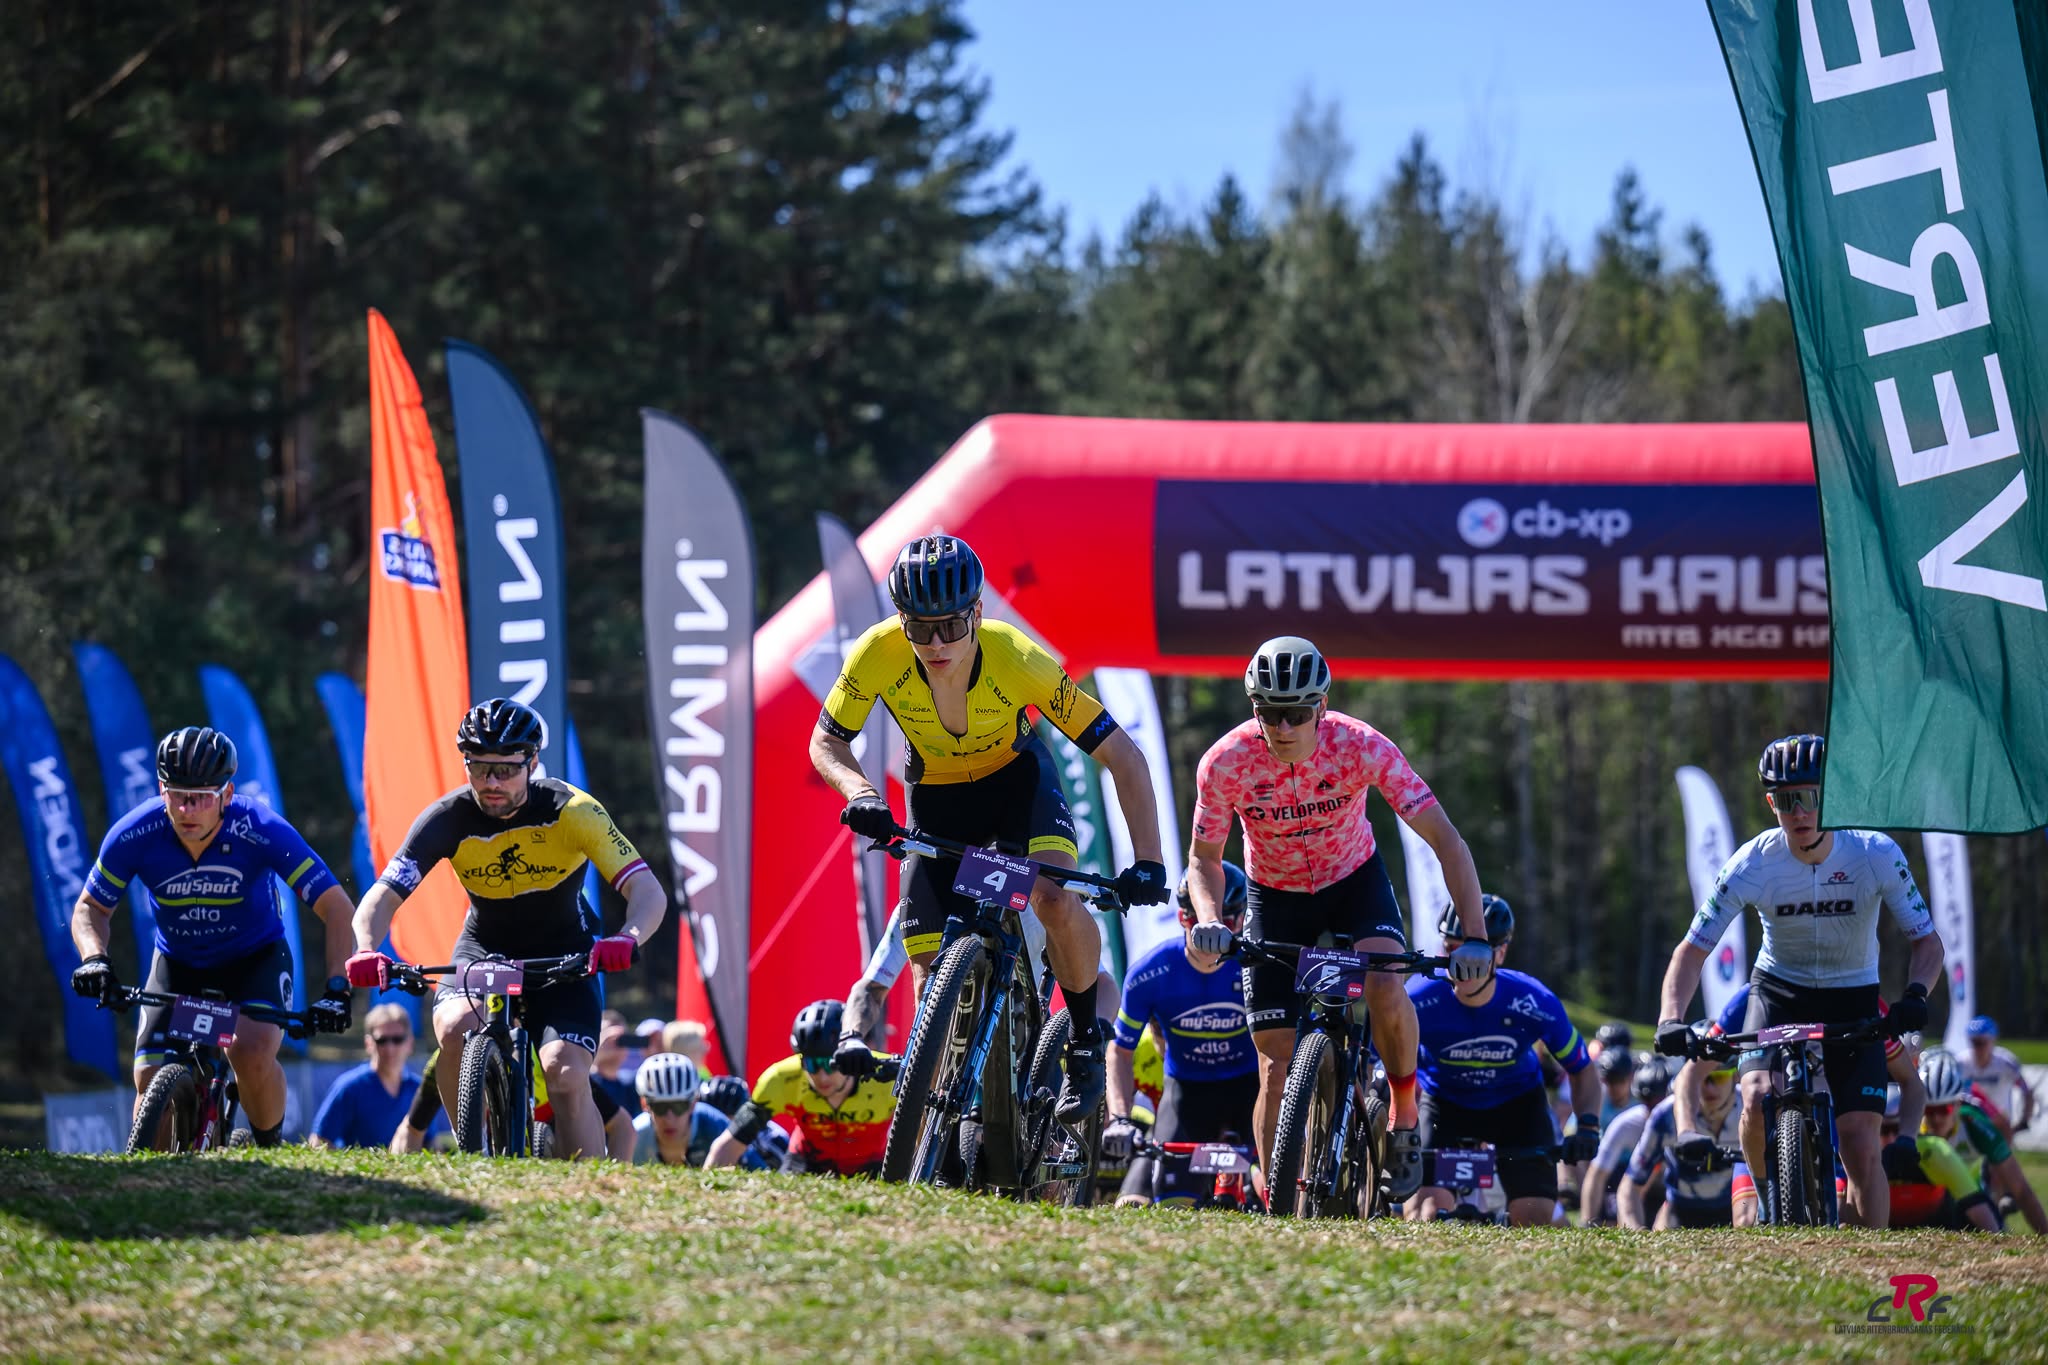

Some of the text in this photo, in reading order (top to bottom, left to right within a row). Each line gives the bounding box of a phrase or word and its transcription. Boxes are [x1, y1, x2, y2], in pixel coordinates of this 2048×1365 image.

[1512, 500, 1631, 547] cb-xp
[1178, 551, 1590, 616] LATVIJAS
[1622, 624, 1701, 649] MTB
[1711, 625, 1784, 649] XCO
[895, 666, 913, 689] ELOT
[992, 686, 1014, 708] ELOT
[1271, 793, 1352, 821] VELOPROFS
[972, 852, 1005, 866] LATVIJAS
[1006, 861, 1031, 873] KAUSS
[166, 879, 239, 896] mySport
[983, 870, 1008, 893] 4
[1012, 896, 1026, 905] XCO
[1776, 900, 1854, 916] DAKO
[484, 972, 495, 987] 1
[192, 1013, 214, 1035] 8
[1180, 1014, 1244, 1030] mySport
[559, 1032, 598, 1052] VELO
[1072, 1049, 1093, 1057] SIDI
[1450, 1045, 1514, 1060] mySport
[1209, 1151, 1237, 1167] 10
[1060, 1166, 1083, 1175] SCOTT
[1455, 1161, 1473, 1180] 5
